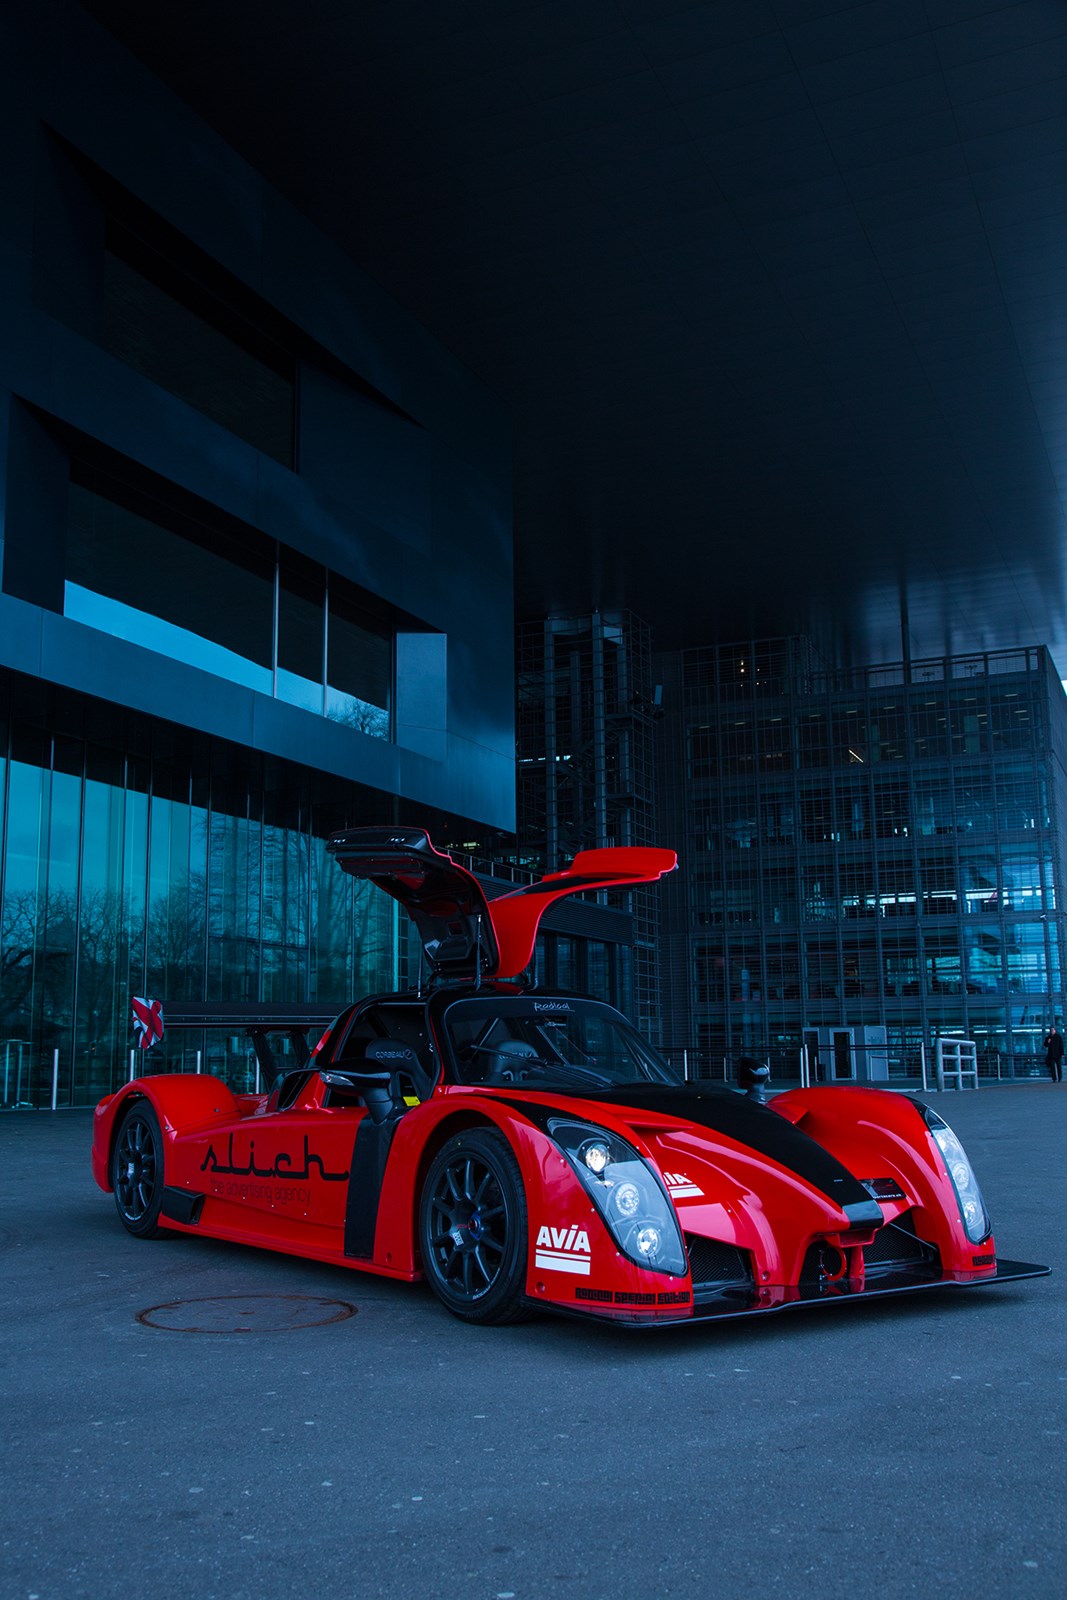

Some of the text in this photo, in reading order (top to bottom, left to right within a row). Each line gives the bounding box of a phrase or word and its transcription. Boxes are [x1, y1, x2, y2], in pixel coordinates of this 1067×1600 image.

[375, 1051, 404, 1059] CORBEAU
[226, 1181, 273, 1203] advertising
[274, 1186, 311, 1206] agency
[536, 1224, 591, 1253] AVIA
